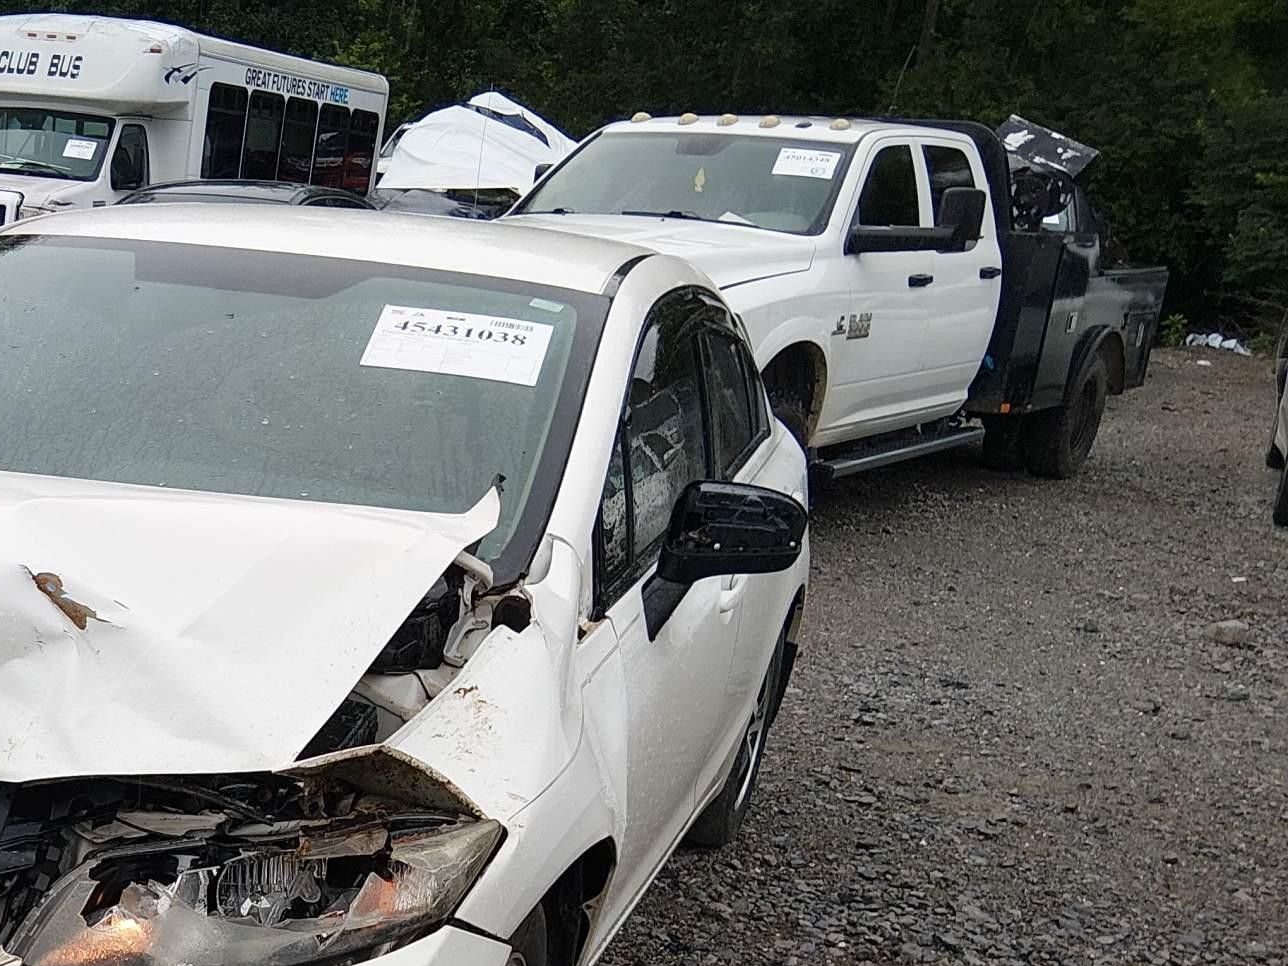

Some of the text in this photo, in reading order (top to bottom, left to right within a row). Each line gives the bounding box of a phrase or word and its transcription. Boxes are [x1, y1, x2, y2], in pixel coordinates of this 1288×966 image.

[47, 54, 84, 79] BUS
[245, 68, 273, 88] GREAT
[272, 73, 307, 97] FUTURES
[306, 81, 330, 101] START
[394, 319, 528, 346] 45431038
